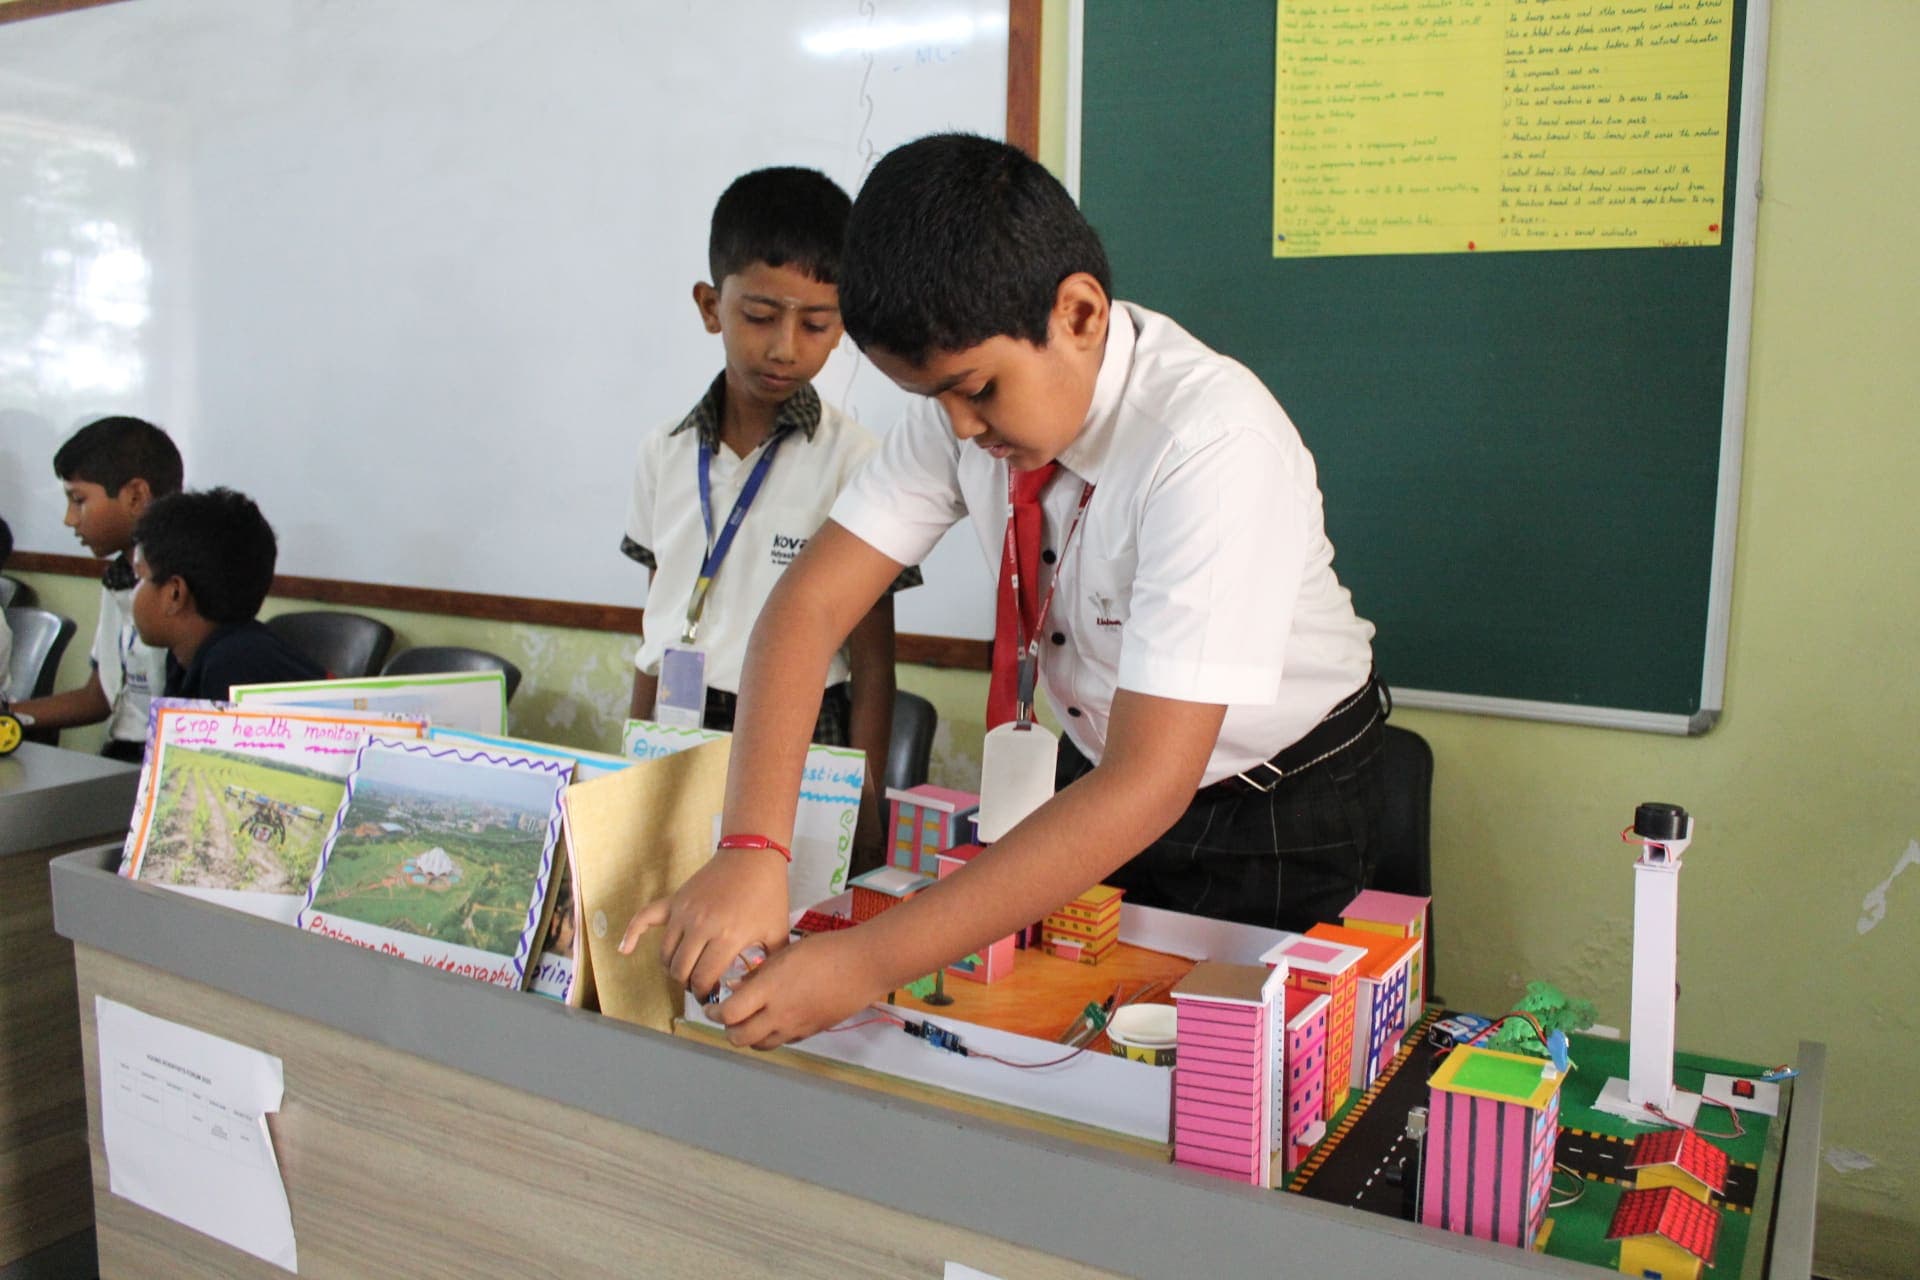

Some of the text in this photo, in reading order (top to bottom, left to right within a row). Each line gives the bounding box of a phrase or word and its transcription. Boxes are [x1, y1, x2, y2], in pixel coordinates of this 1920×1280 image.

[175, 715, 366, 742] Crop health monitor
[634, 737, 680, 758] Dro
